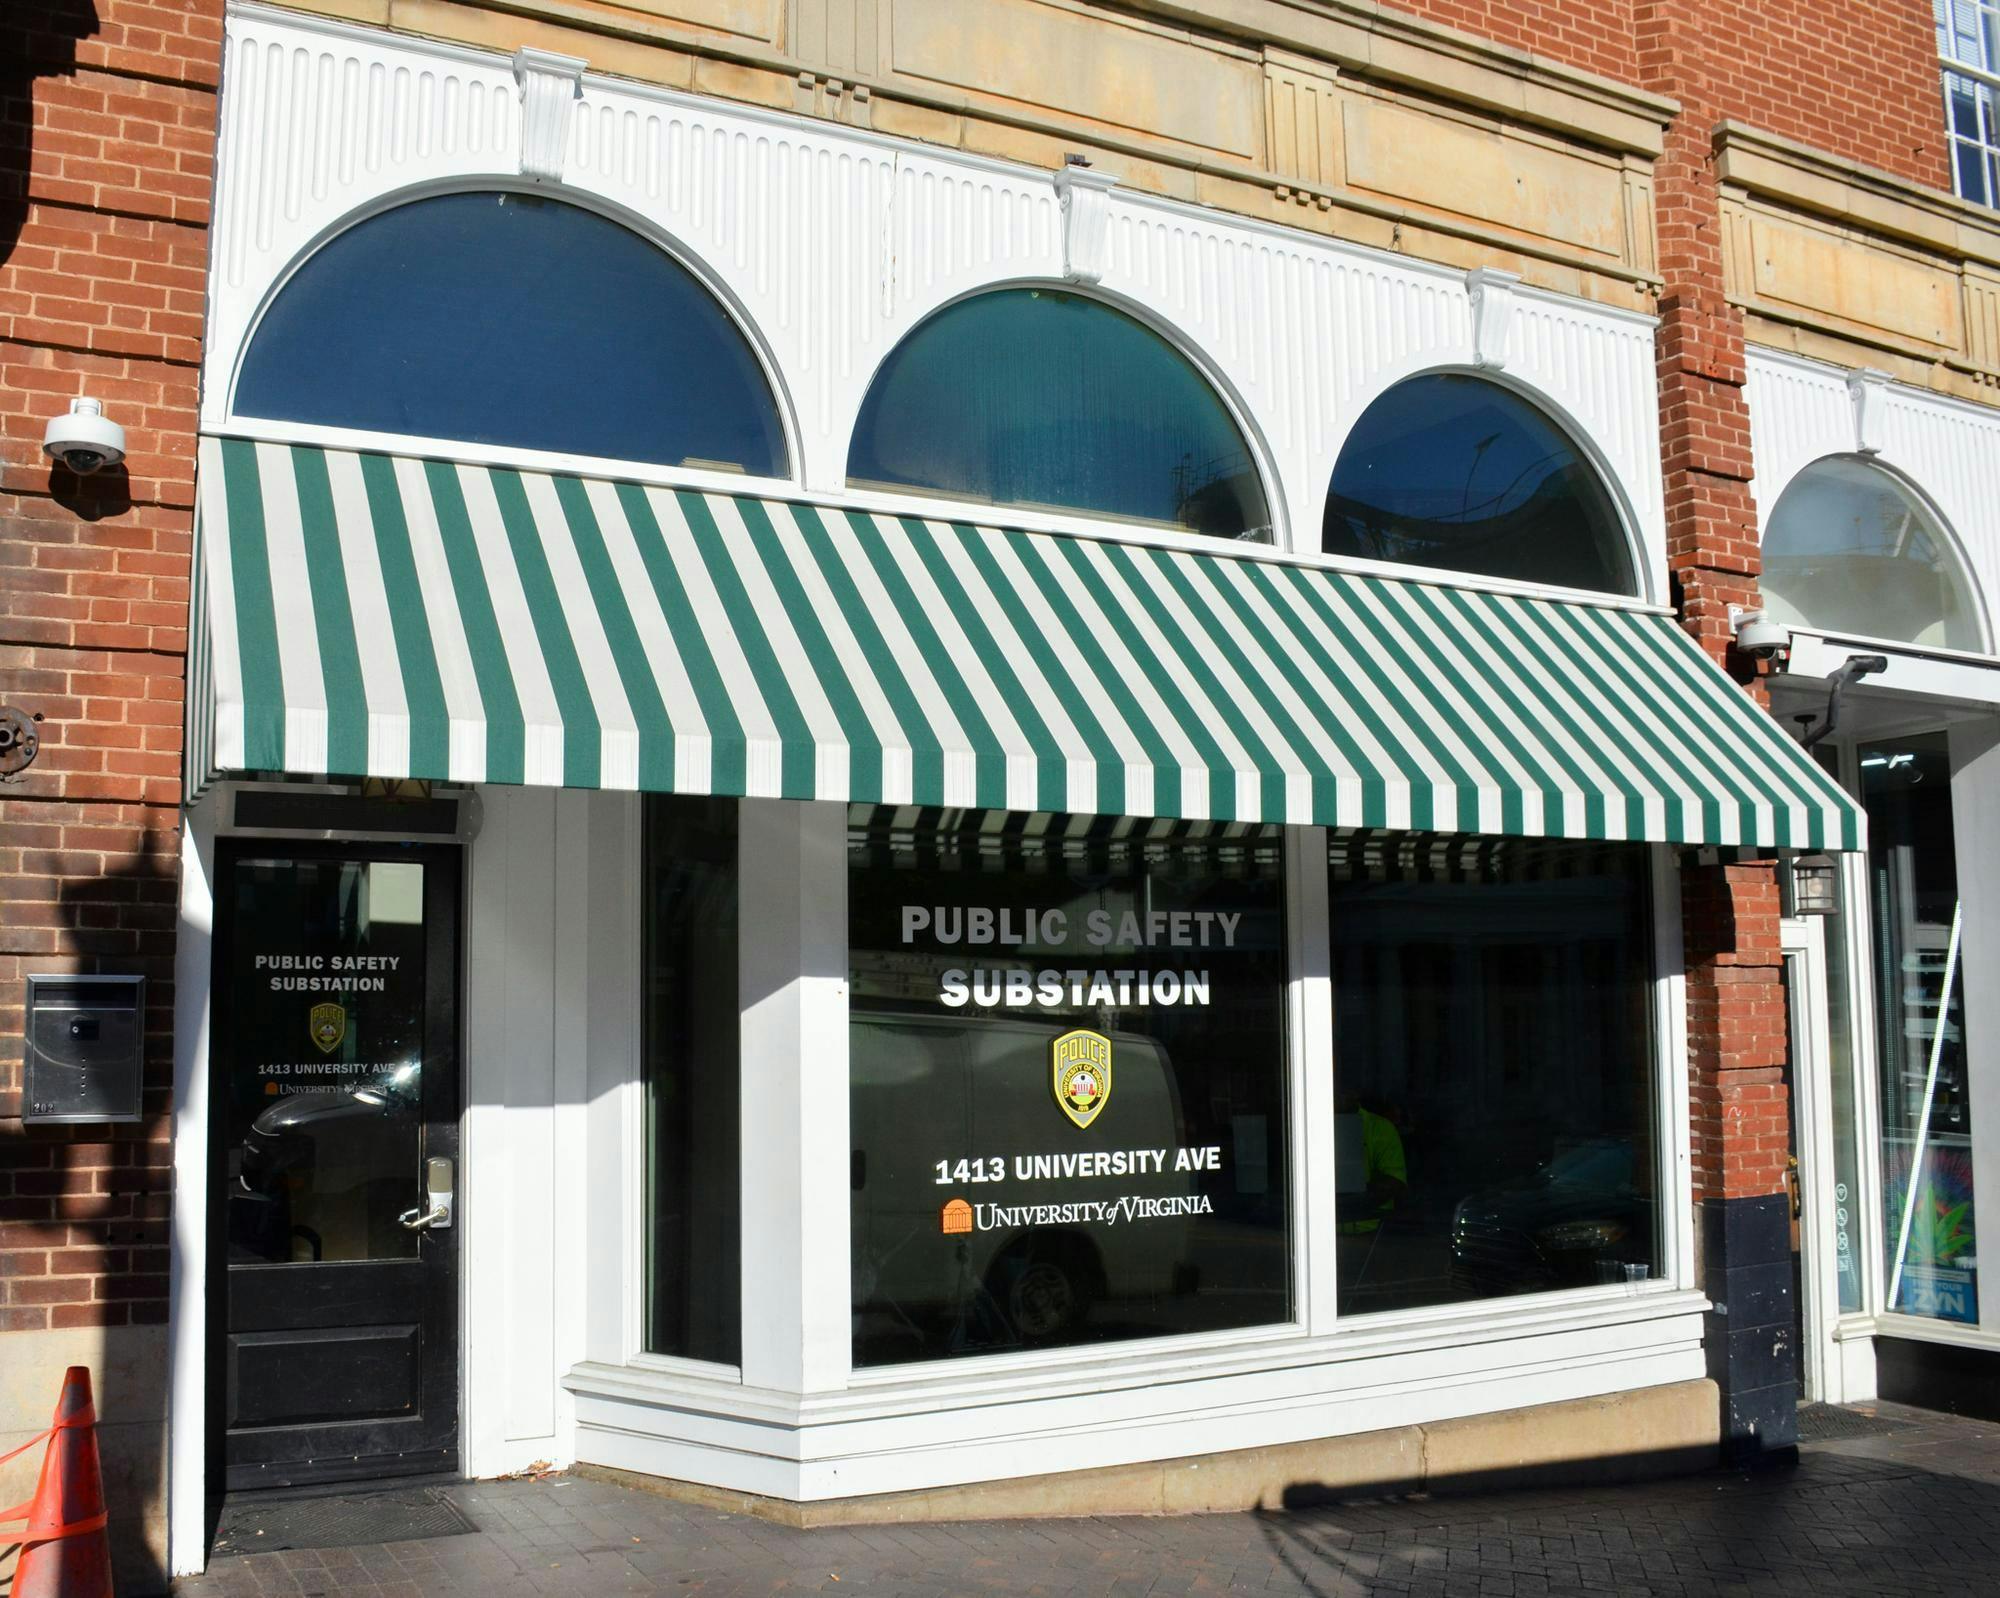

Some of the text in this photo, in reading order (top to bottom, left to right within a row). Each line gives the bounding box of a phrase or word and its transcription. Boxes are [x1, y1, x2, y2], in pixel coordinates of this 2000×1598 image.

[902, 905, 1242, 948] PUBLIC SAFETY
[255, 955, 400, 970] PUBLIC SAFETY
[270, 977, 385, 991] SUBSTATION
[939, 968, 1210, 1007] SUBSTATION
[313, 1007, 343, 1023] POLICE
[1059, 1037, 1107, 1071] POLICE
[257, 1063, 396, 1075] 1413 UNIVERSITY AVE
[1083, 1064, 1093, 1072] OF
[279, 1083, 337, 1095] UNIVERSITY
[935, 1146, 1221, 1184] 1413 UNIVERSITY AVE
[975, 1202, 1108, 1231] UNIVERSITY
[1120, 1195, 1213, 1224] VIRGINIA
